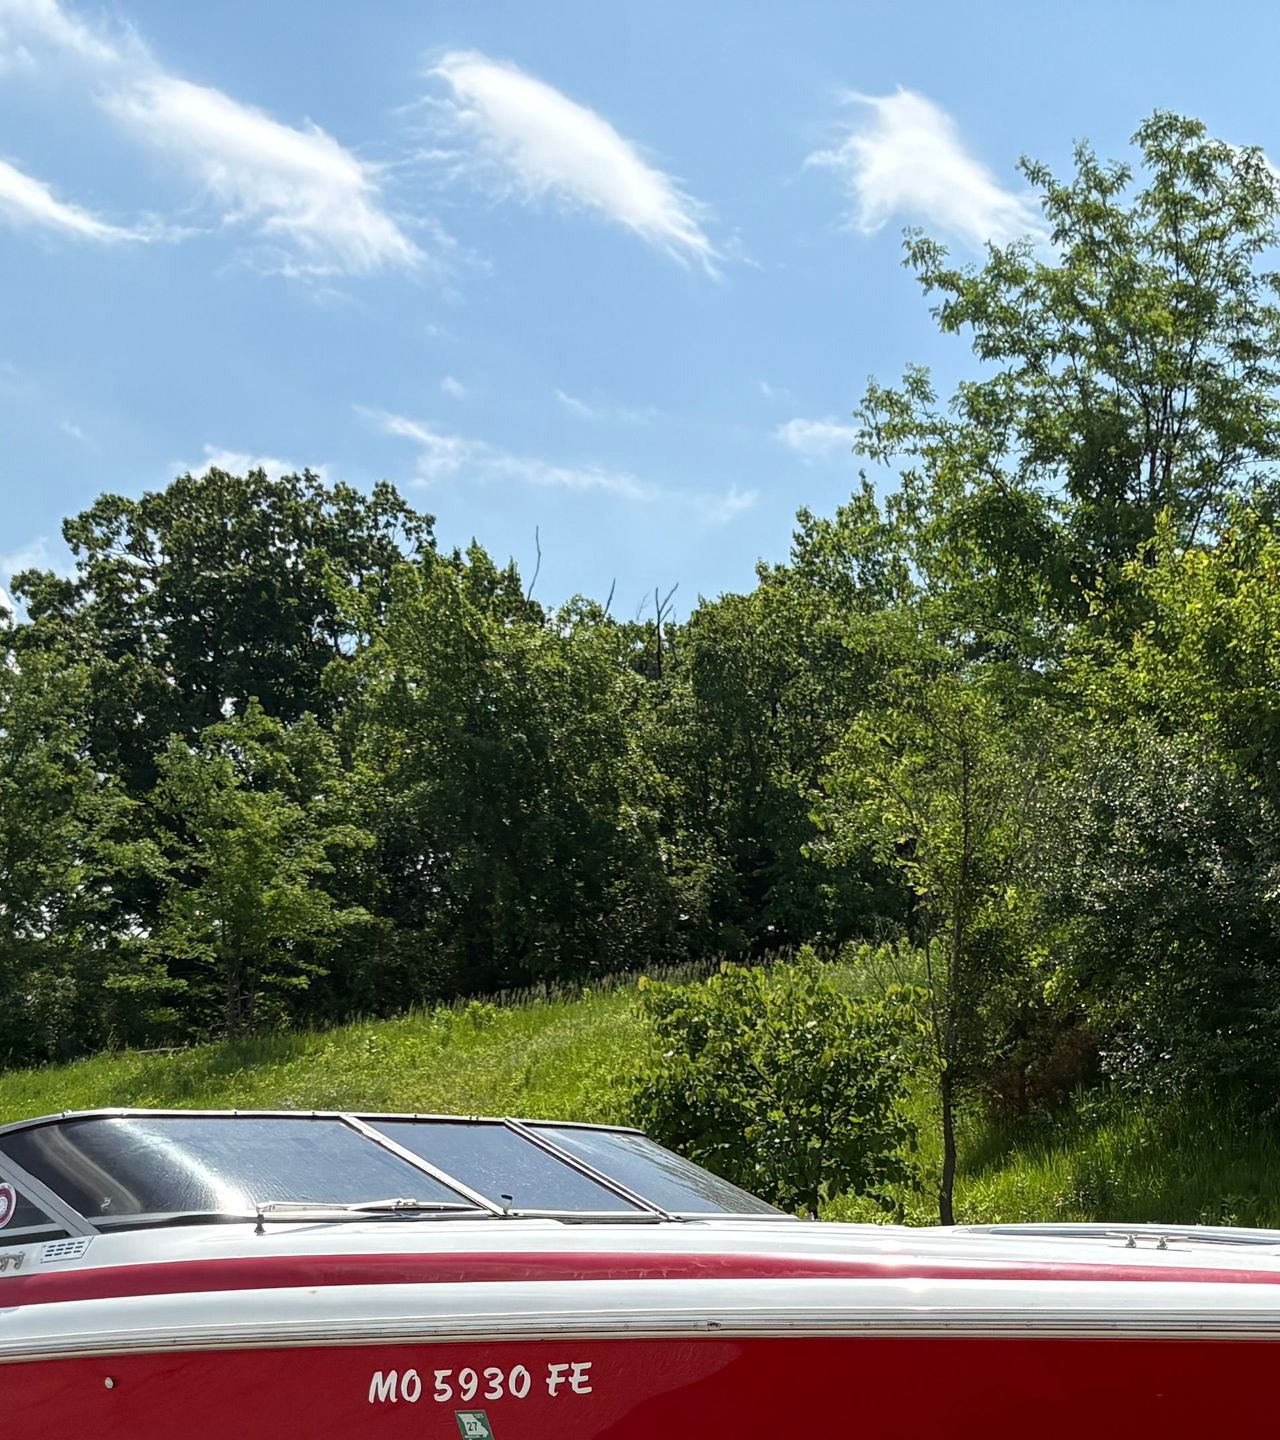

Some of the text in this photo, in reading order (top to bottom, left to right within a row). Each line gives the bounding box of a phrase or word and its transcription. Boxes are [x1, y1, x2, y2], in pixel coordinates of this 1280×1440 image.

[368, 1361, 593, 1404] MO 5930 FE
[466, 1421, 478, 1432] 27
